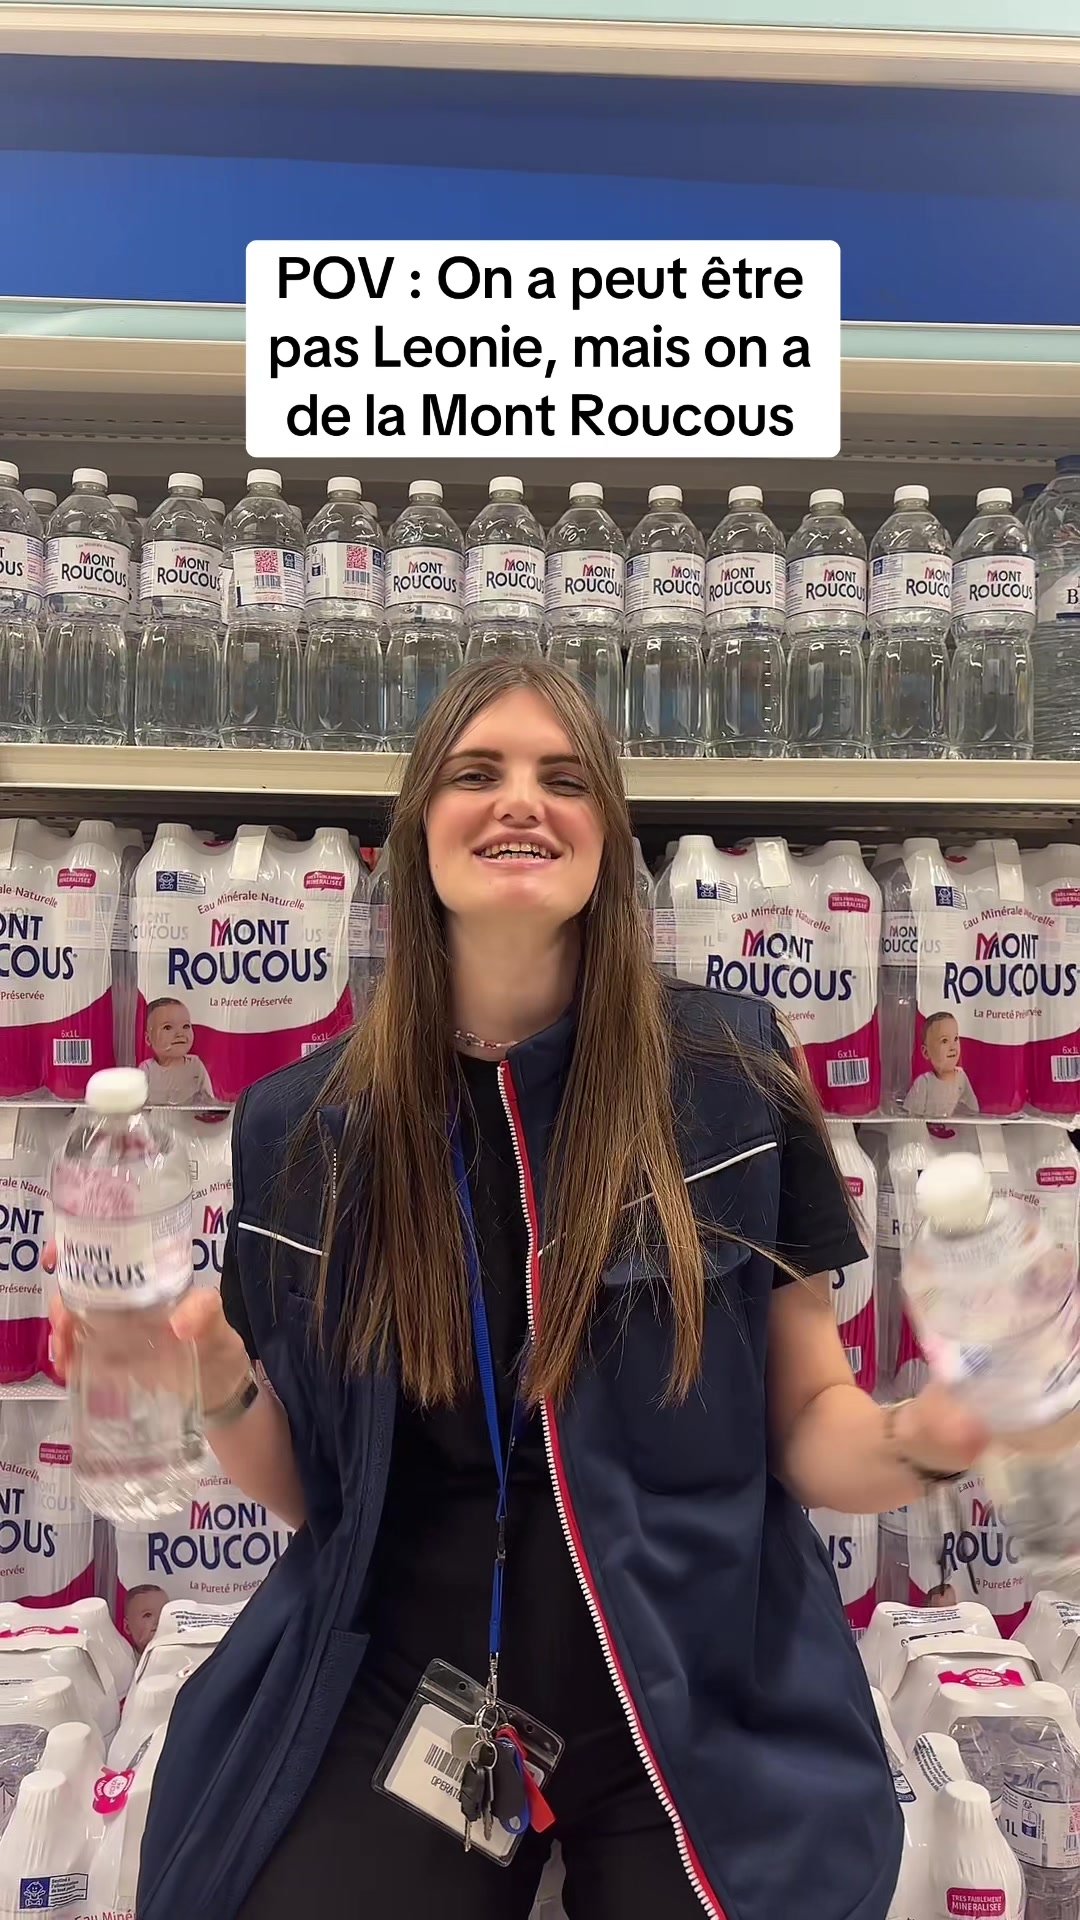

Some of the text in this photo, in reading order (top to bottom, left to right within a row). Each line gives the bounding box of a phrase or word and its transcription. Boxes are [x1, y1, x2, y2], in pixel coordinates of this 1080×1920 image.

[80, 551, 115, 568] MONT
[175, 555, 210, 571] MONT
[408, 561, 442, 574] MONT
[504, 558, 536, 574] MONT
[61, 563, 127, 587] ROUCOUS
[582, 564, 615, 579] MONT
[671, 565, 700, 581] MONT
[720, 567, 755, 582] MONT
[823, 569, 856, 583] MONT
[987, 570, 1022, 583] MONT
[393, 575, 457, 593] ROUCOUS
[709, 580, 772, 602] ROUCOUS
[969, 583, 1033, 600] ROUCOUS
[198, 890, 305, 915] Eau Minérale Naturelle
[731, 912, 748, 924] Eau
[751, 904, 794, 917] Minérale
[963, 919, 979, 930] Eau
[981, 906, 1023, 921] Minérale
[211, 917, 289, 946] MONT
[742, 929, 813, 963] MONT
[975, 932, 1039, 961] MONT
[168, 948, 328, 990] ROUCOUS
[706, 954, 853, 1001] ROUCOUS
[944, 962, 1077, 1004] ROUCOUS
[1, 990, 45, 1001] Préservée
[210, 995, 293, 1007] La Pureté Préservée
[974, 1009, 984, 1018] La
[986, 1009, 1014, 1019] Pureté
[837, 1050, 858, 1058] 6x1L
[190, 1501, 267, 1530] MONT
[148, 1531, 293, 1575] ROUCOU
[944, 1531, 1024, 1571] ROUC
[190, 1581, 199, 1589] La
[201, 1582, 230, 1593] Pureté
[982, 1578, 1012, 1589] Pureté
[1005, 1818, 1018, 1838] 1L
